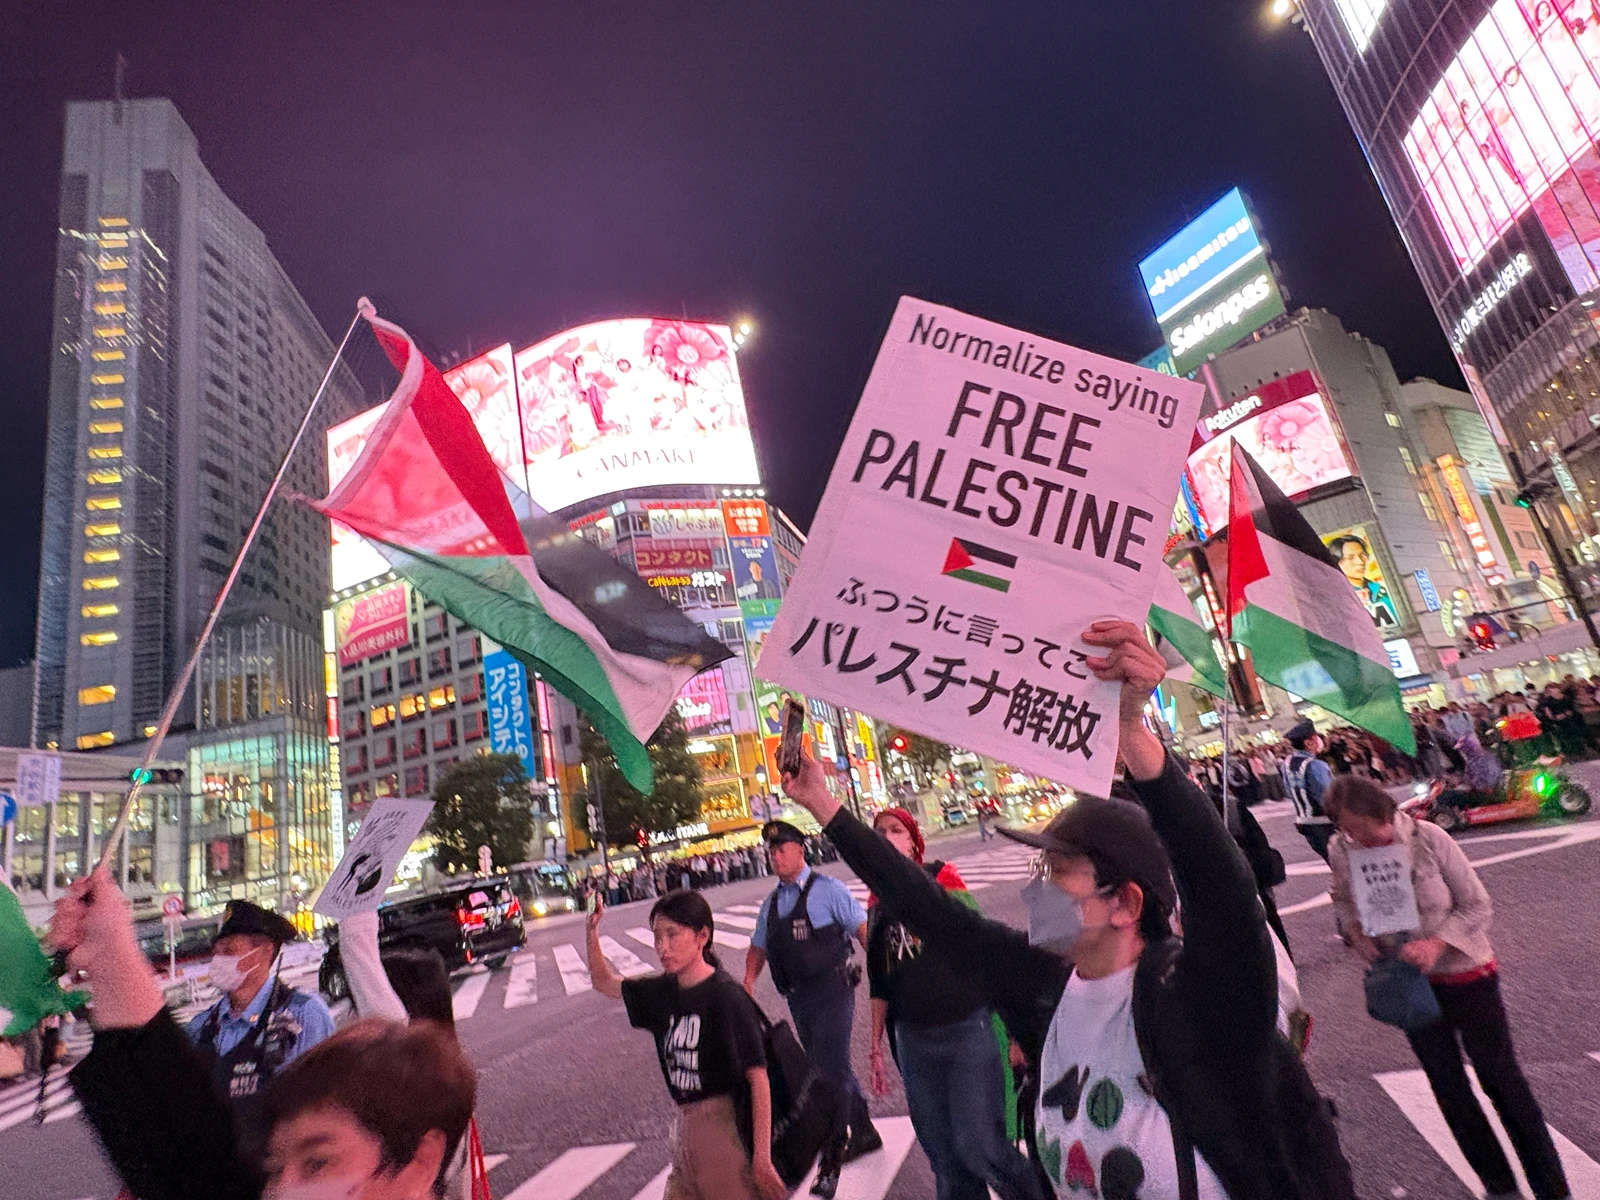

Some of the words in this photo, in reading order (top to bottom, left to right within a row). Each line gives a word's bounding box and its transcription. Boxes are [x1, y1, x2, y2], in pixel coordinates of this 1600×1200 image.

[1170, 274, 1270, 357] Salonpas
[909, 314, 1066, 384] Normalize
[1074, 367, 1179, 429] saying
[1205, 394, 1263, 432] Rakuten
[577, 448, 694, 478] ANMAK
[946, 381, 1101, 478] FREE
[851, 429, 1154, 572] PALESTINE
[637, 551, 710, 566] コンタクト
[691, 571, 726, 587] ガスト
[507, 662, 529, 760] コンタクトの
[789, 617, 1102, 761] パレスチナ解放
